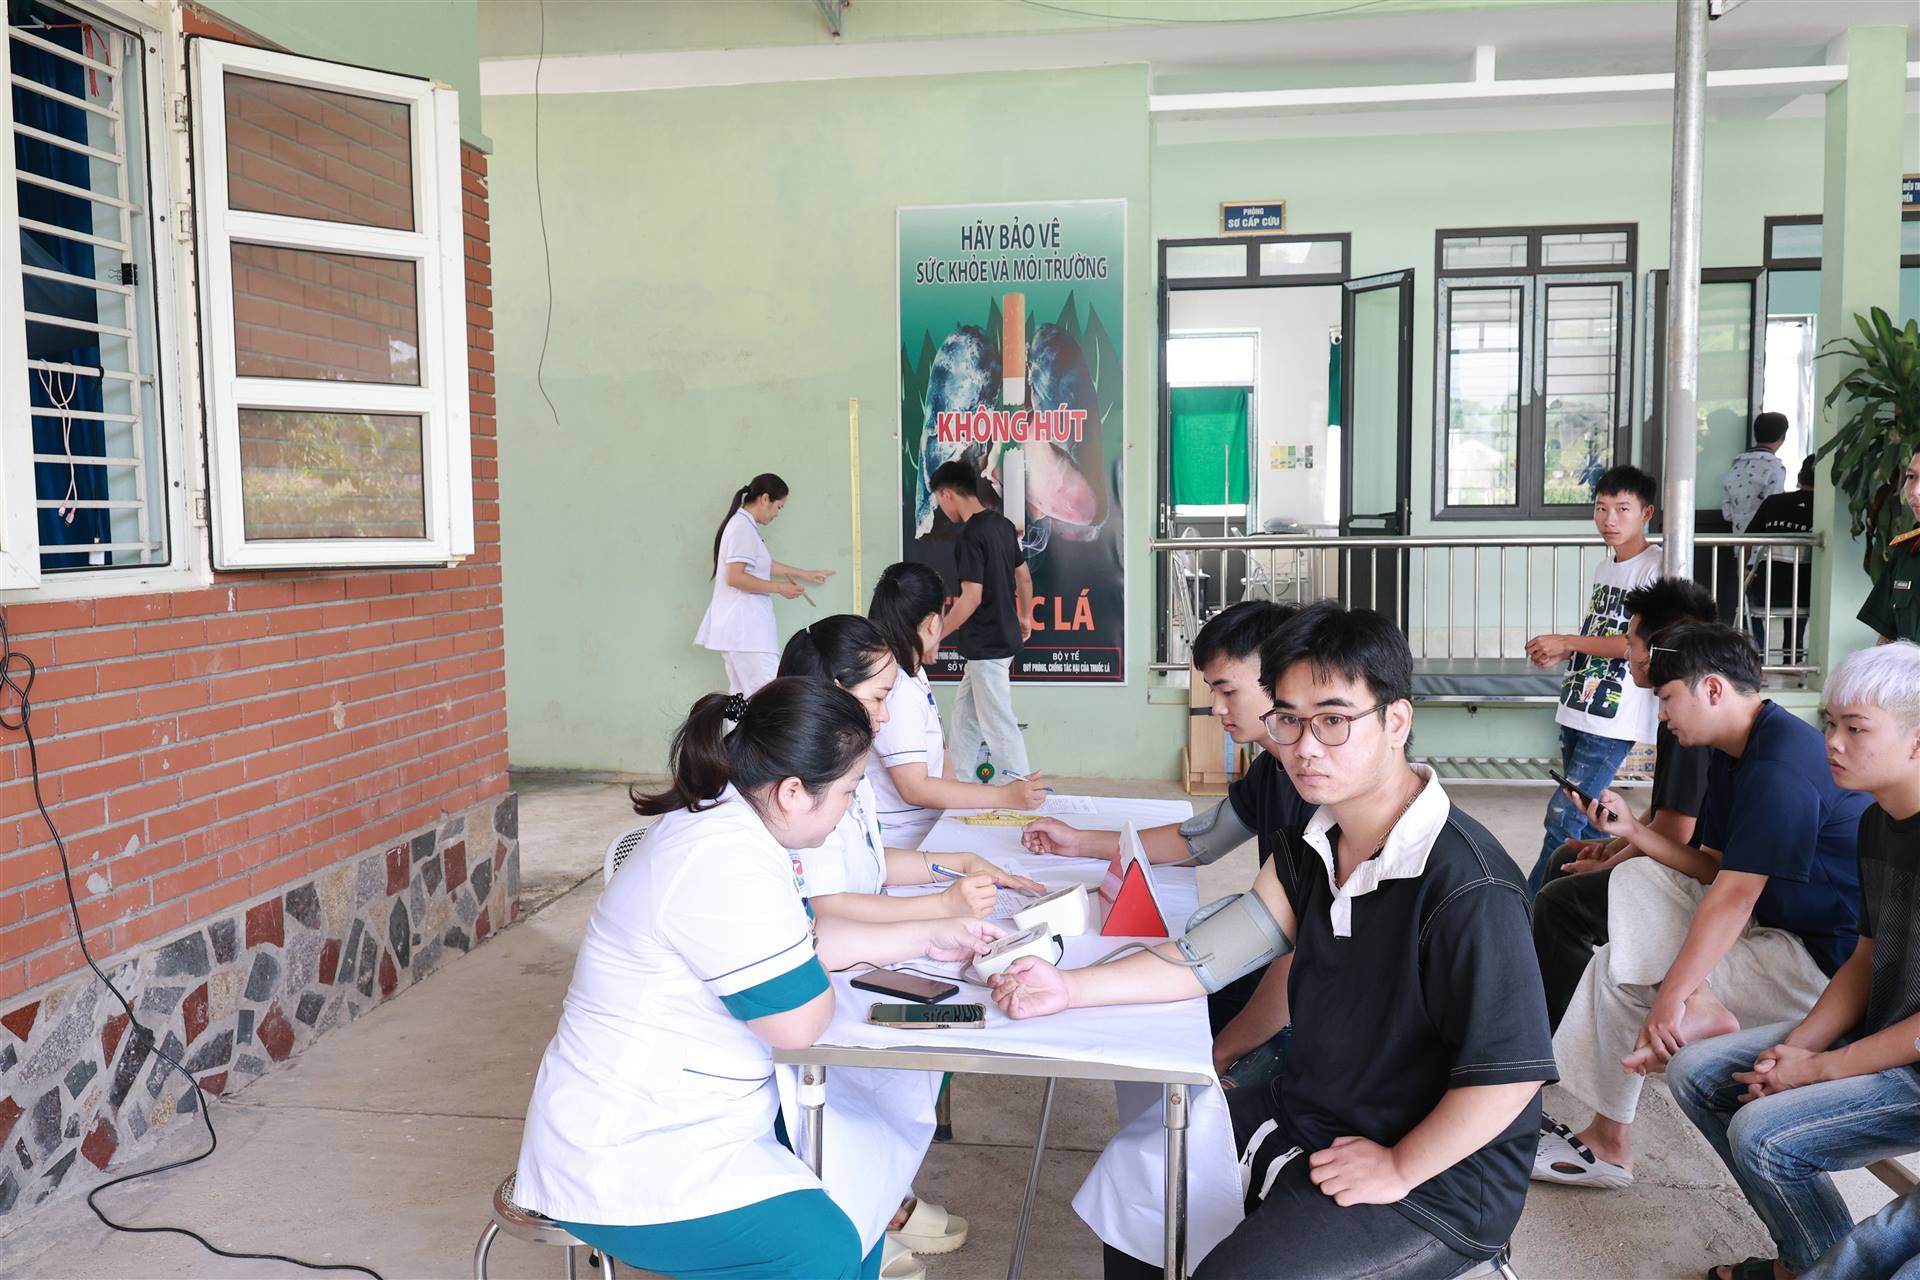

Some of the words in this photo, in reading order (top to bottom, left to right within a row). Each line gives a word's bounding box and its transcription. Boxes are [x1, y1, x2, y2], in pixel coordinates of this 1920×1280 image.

[961, 219, 995, 251] HÃY
[1000, 216, 1035, 250] BẢO
[1039, 217, 1060, 255] VỆ
[1228, 218, 1240, 228] SƠ
[1242, 215, 1260, 227] CẤP
[1262, 215, 1280, 226] CỨU
[916, 257, 945, 283] SỨC
[948, 254, 987, 282] KHỎE
[990, 256, 1009, 281] VÀ
[1013, 255, 1041, 281] MÔI
[1045, 253, 1107, 280] TRƯỜNG
[937, 405, 1029, 443] KHÔNG
[1034, 403, 1088, 442] HÚT
[1054, 588, 1096, 632] LÁ
[1052, 651, 1063, 661] BỘ
[1064, 652, 1069, 660] Y
[1070, 650, 1080, 660] TẾ
